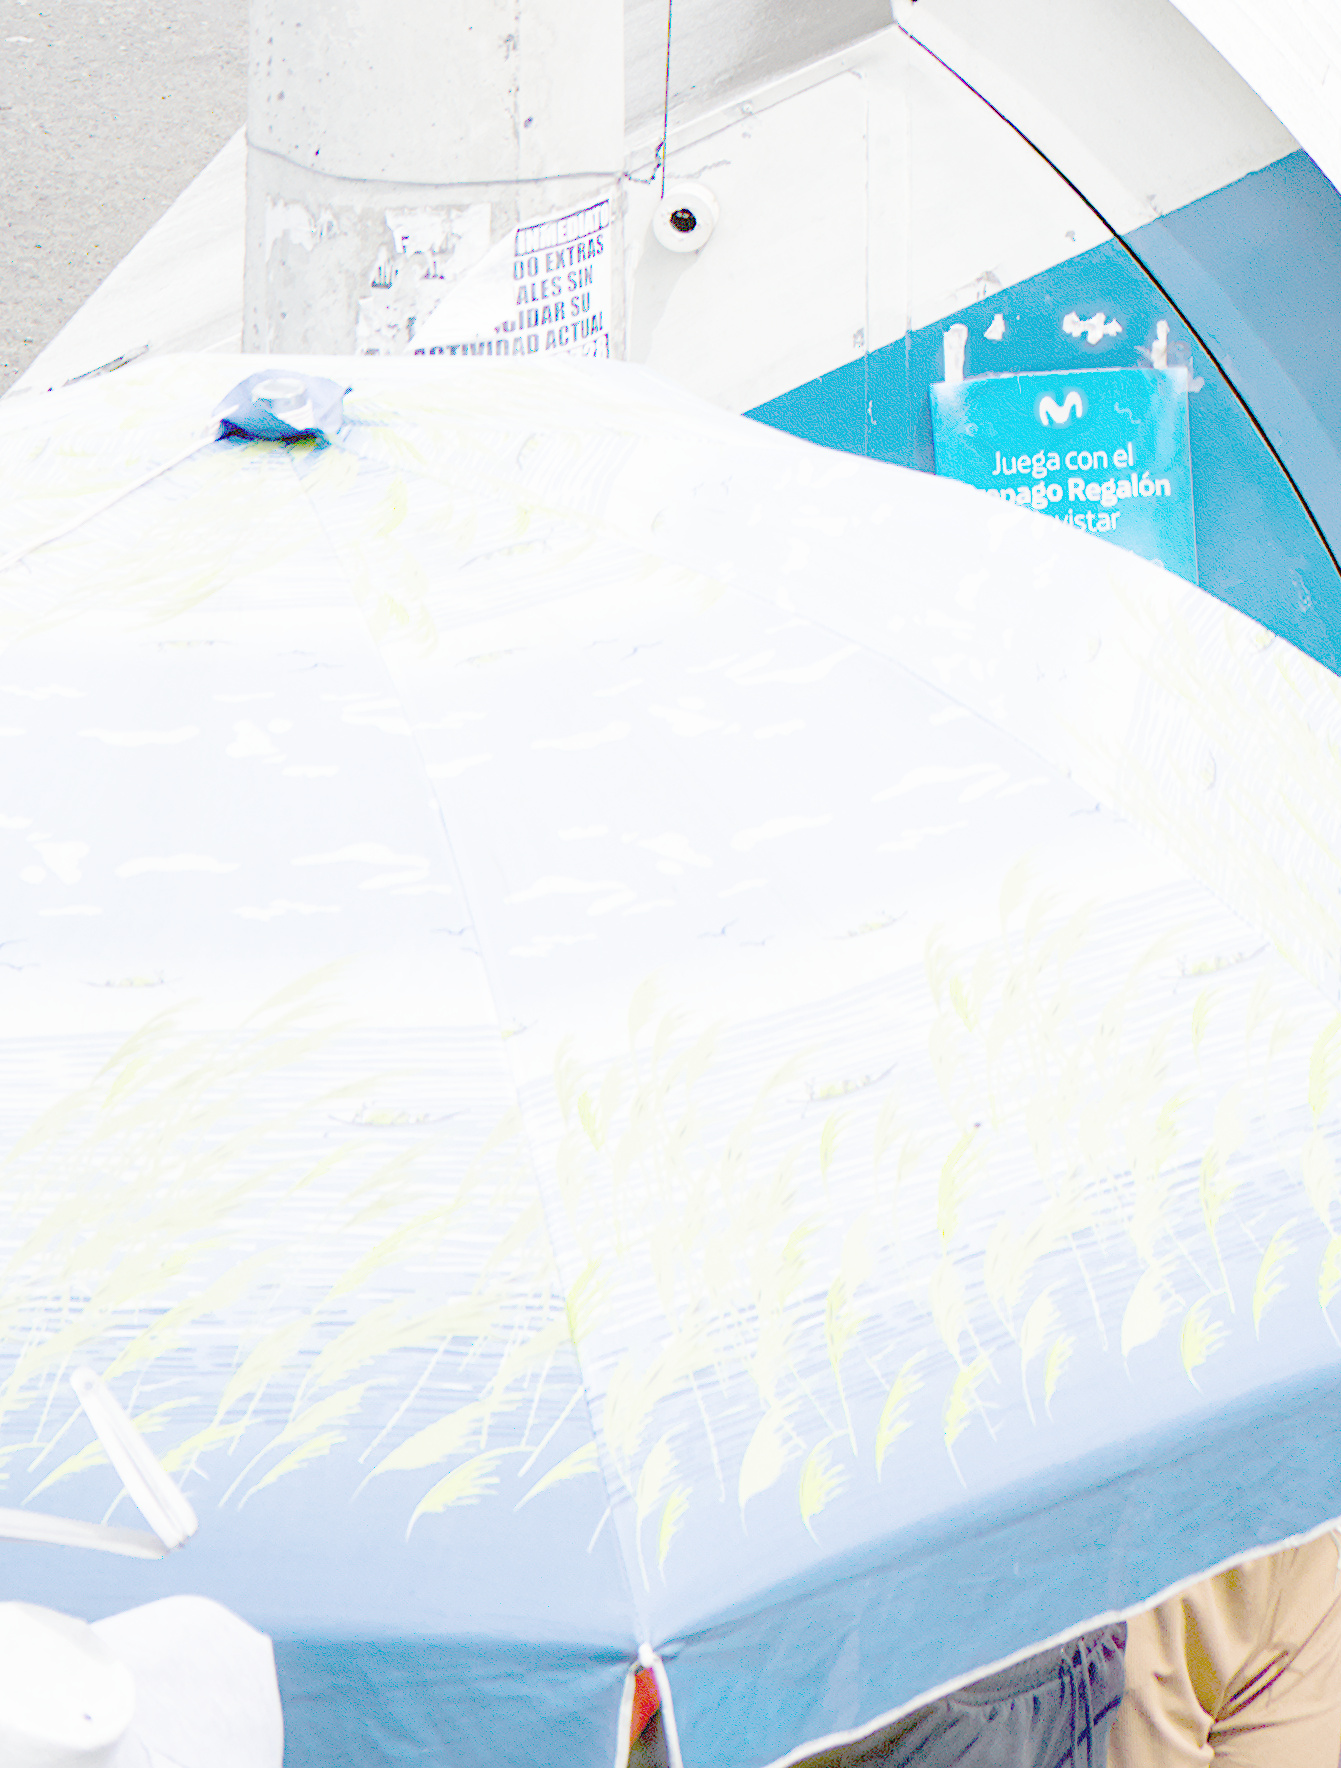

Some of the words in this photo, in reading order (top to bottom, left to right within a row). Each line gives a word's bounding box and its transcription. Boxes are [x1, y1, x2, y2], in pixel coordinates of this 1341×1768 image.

[545, 234, 605, 274] EXTRAS
[516, 276, 563, 306] ALES
[567, 264, 593, 292] SIN
[570, 292, 592, 317] SU
[992, 449, 1061, 480] Juega
[1065, 450, 1109, 471] con
[1113, 441, 1134, 468] el
[1067, 470, 1171, 508] Regalón
